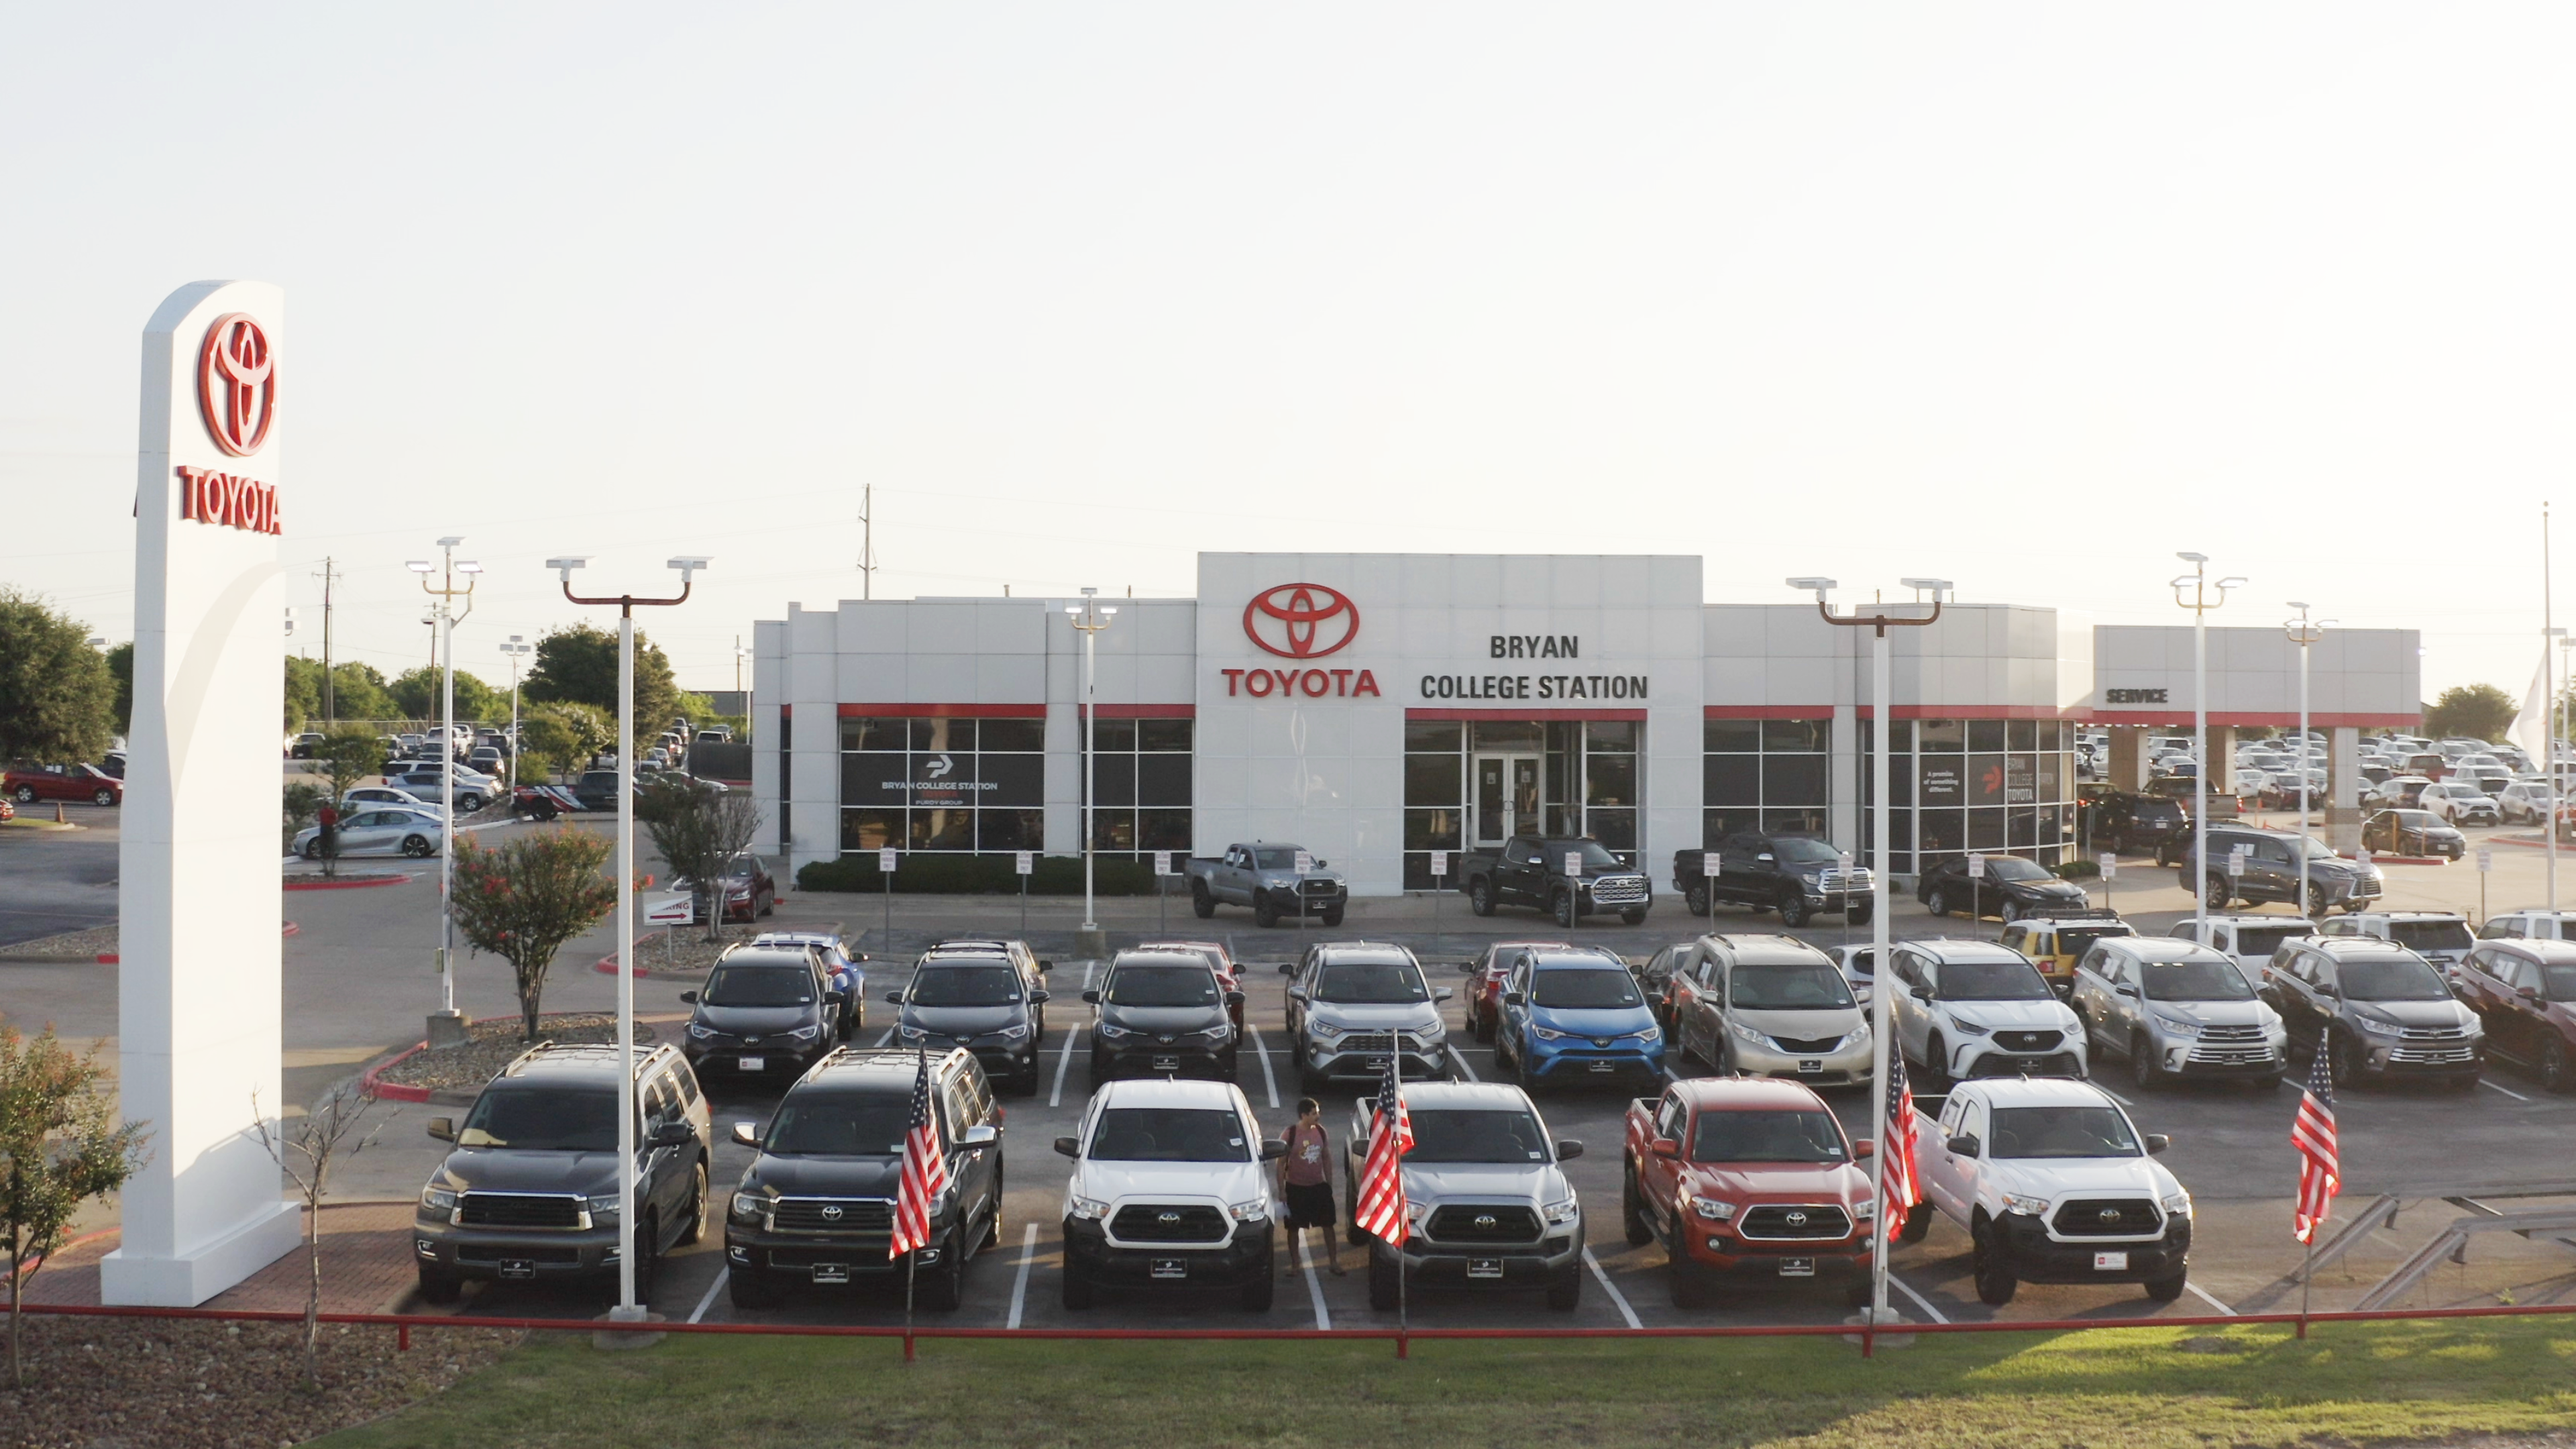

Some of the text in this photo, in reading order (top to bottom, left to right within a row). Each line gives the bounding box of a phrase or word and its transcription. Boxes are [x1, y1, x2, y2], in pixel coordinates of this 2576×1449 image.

[176, 465, 282, 535] TOYOTA
[1491, 635, 1578, 658] BRYAN
[1221, 668, 1381, 698] TOYOTA
[1421, 675, 1648, 699] COLLEGE STATION
[2106, 689, 2168, 703] SERVICE
[2008, 789, 2033, 801] TOYOTA
